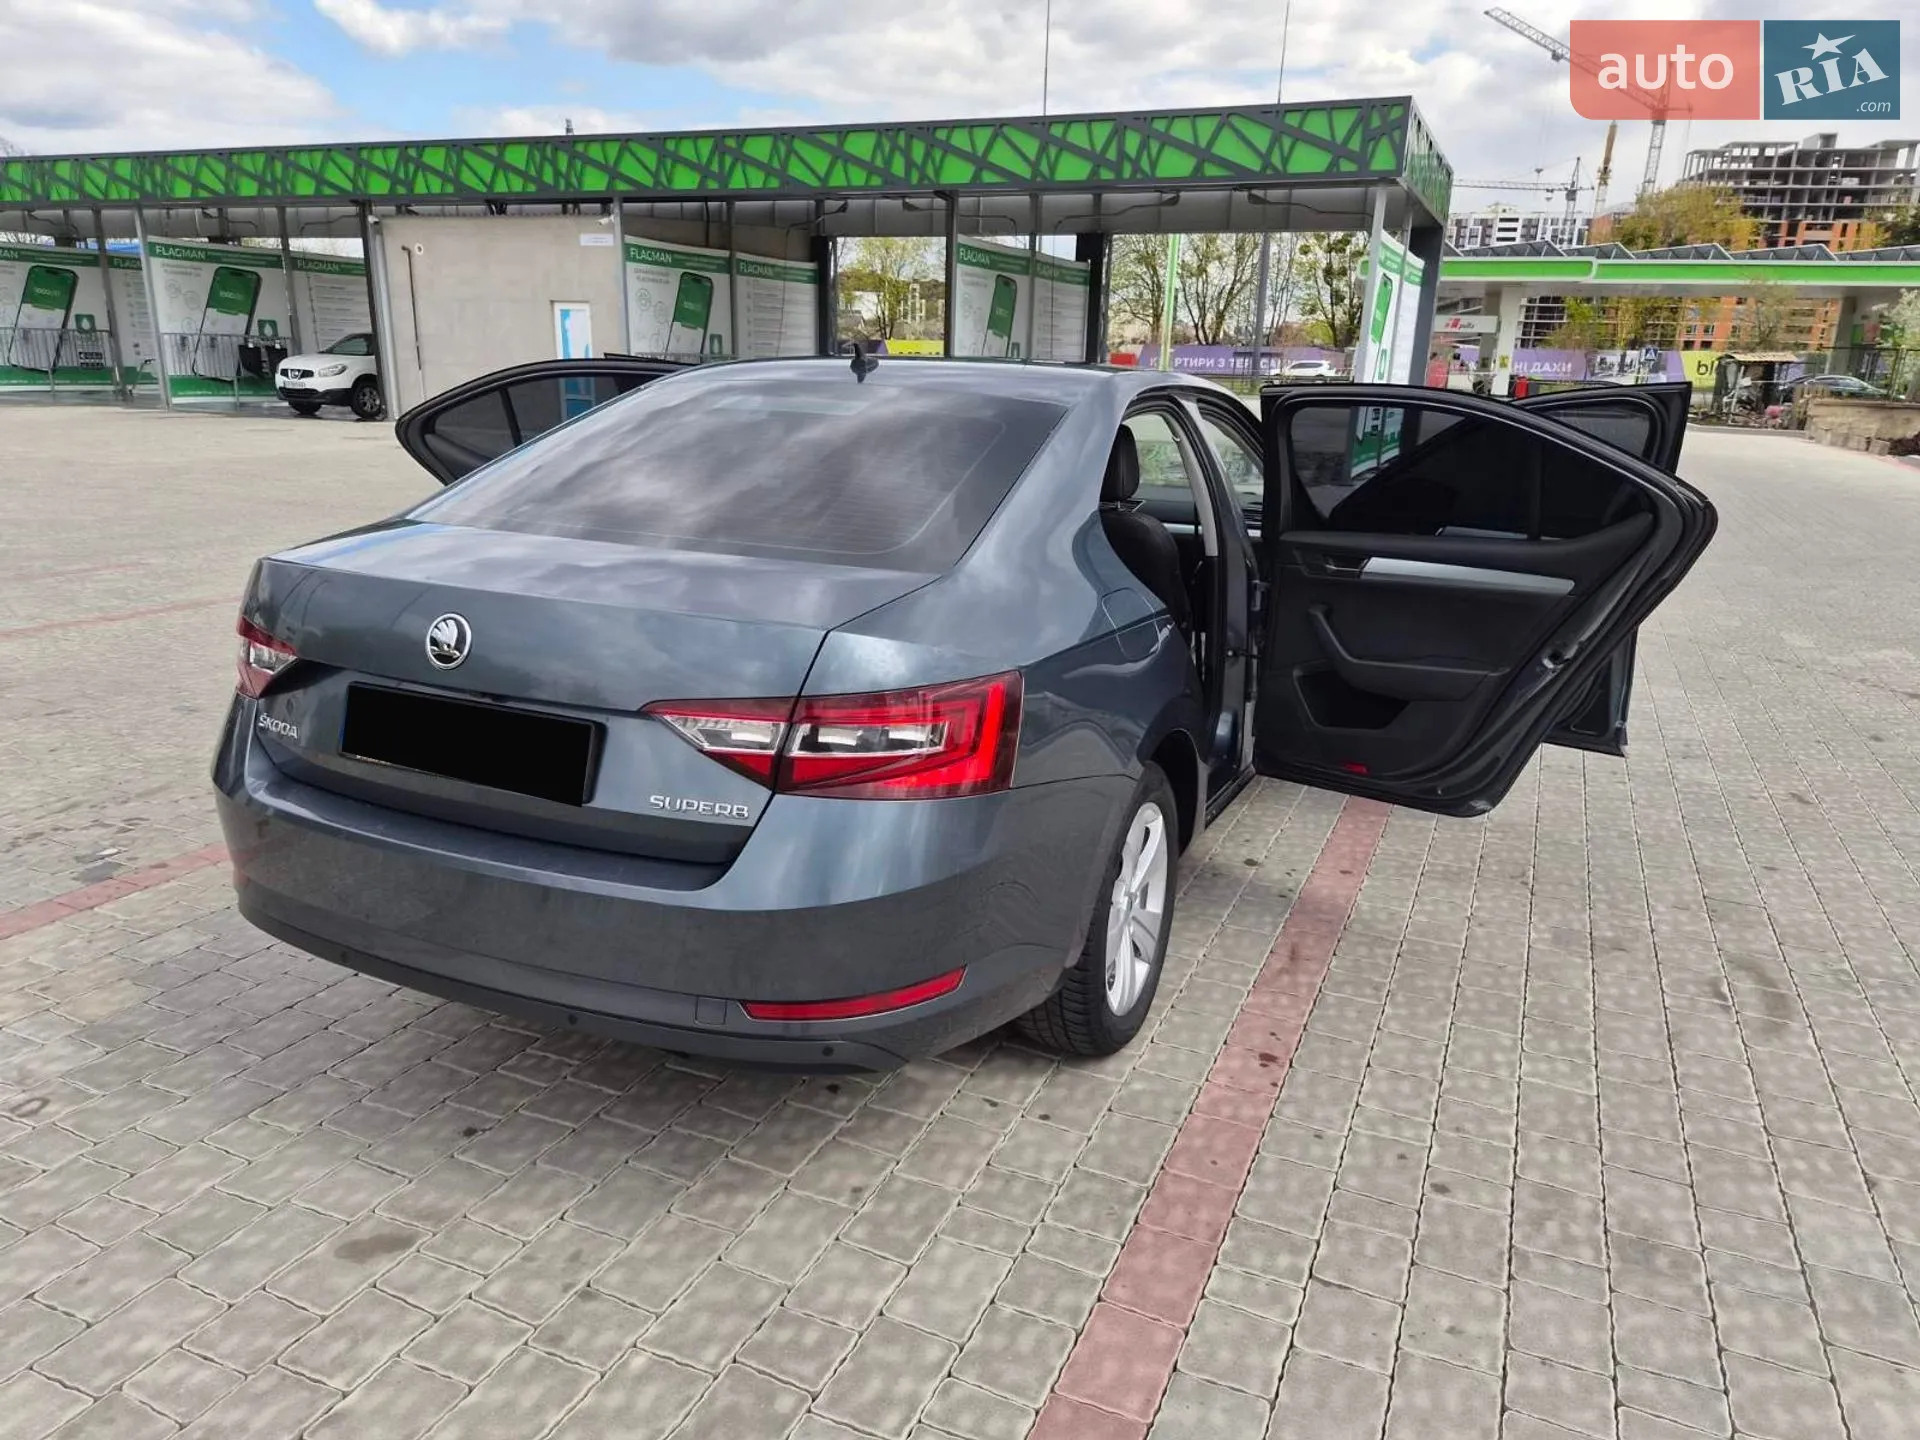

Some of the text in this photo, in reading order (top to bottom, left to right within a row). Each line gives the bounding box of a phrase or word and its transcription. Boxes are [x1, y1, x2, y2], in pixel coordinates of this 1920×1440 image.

[155, 245, 206, 259] FLAGMAN
[630, 247, 672, 263] FLAGMAN
[1150, 357, 1215, 368] КРТИРИ
[258, 712, 298, 739] ŠKODA
[650, 795, 749, 819] SUPERB
